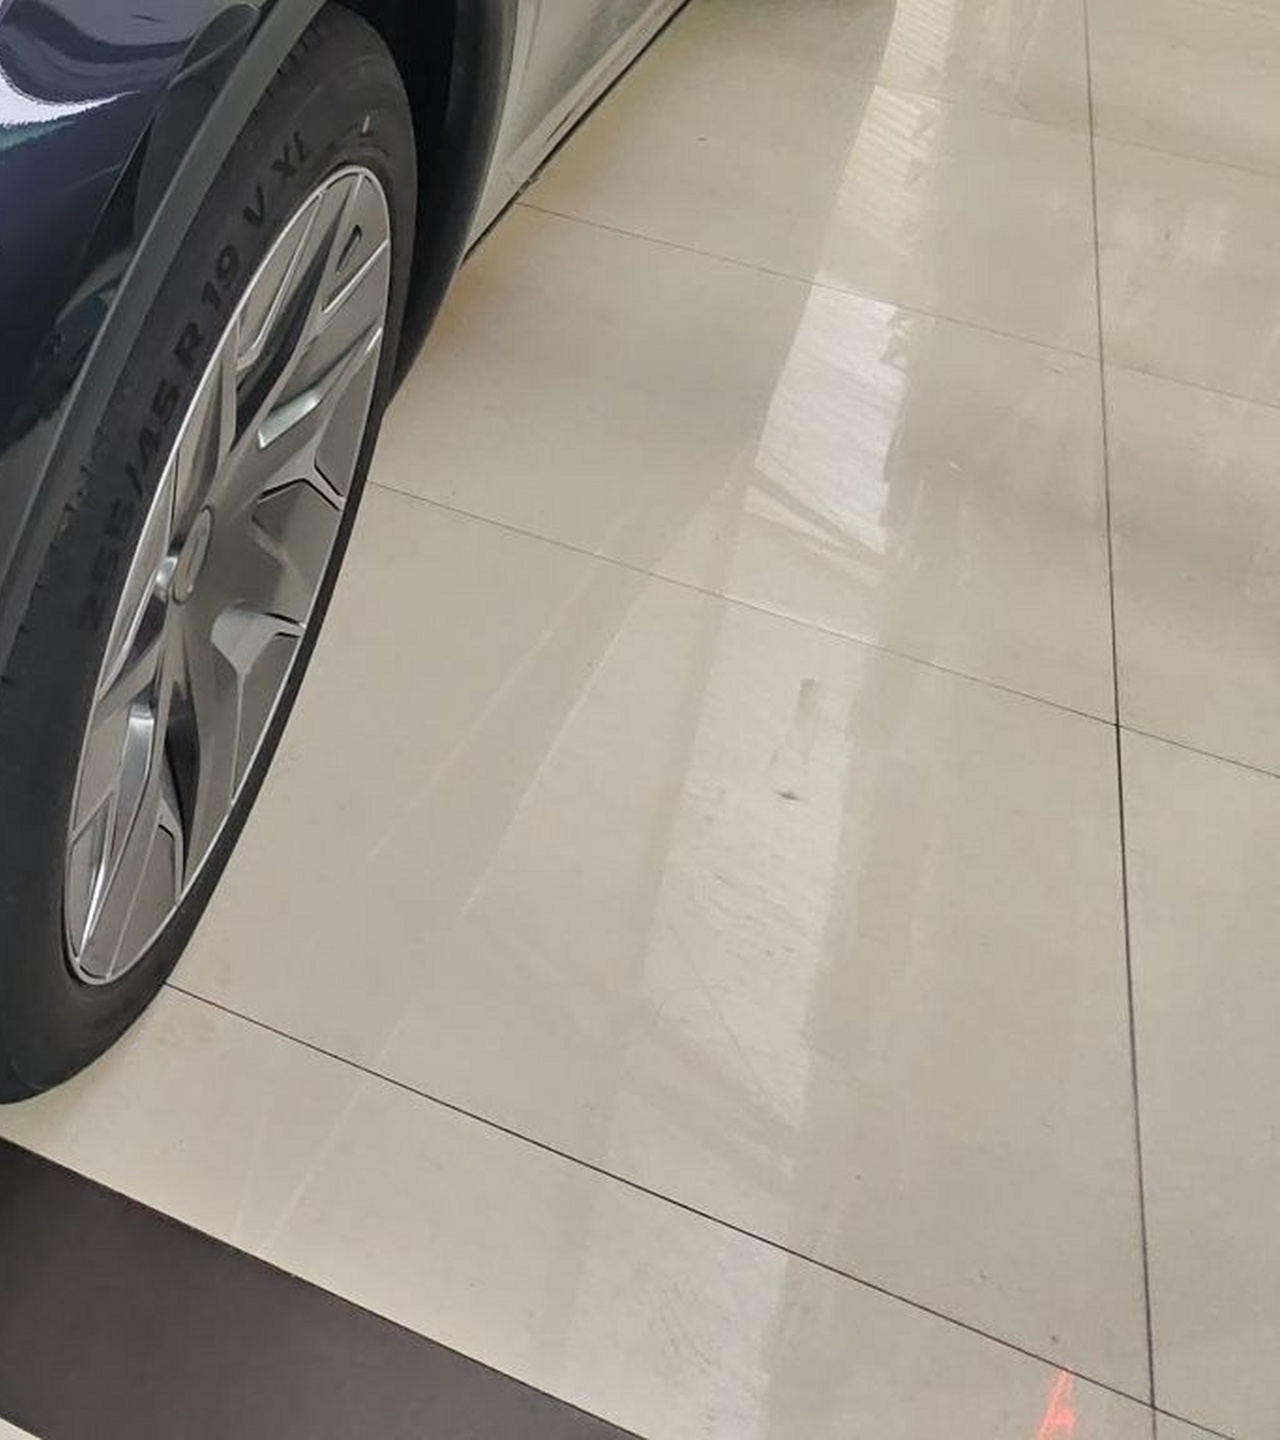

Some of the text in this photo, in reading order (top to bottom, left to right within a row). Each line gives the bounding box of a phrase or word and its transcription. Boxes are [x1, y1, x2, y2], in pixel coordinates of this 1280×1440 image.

[172, 320, 206, 375] R
[201, 244, 242, 312] 19
[243, 185, 267, 230] V
